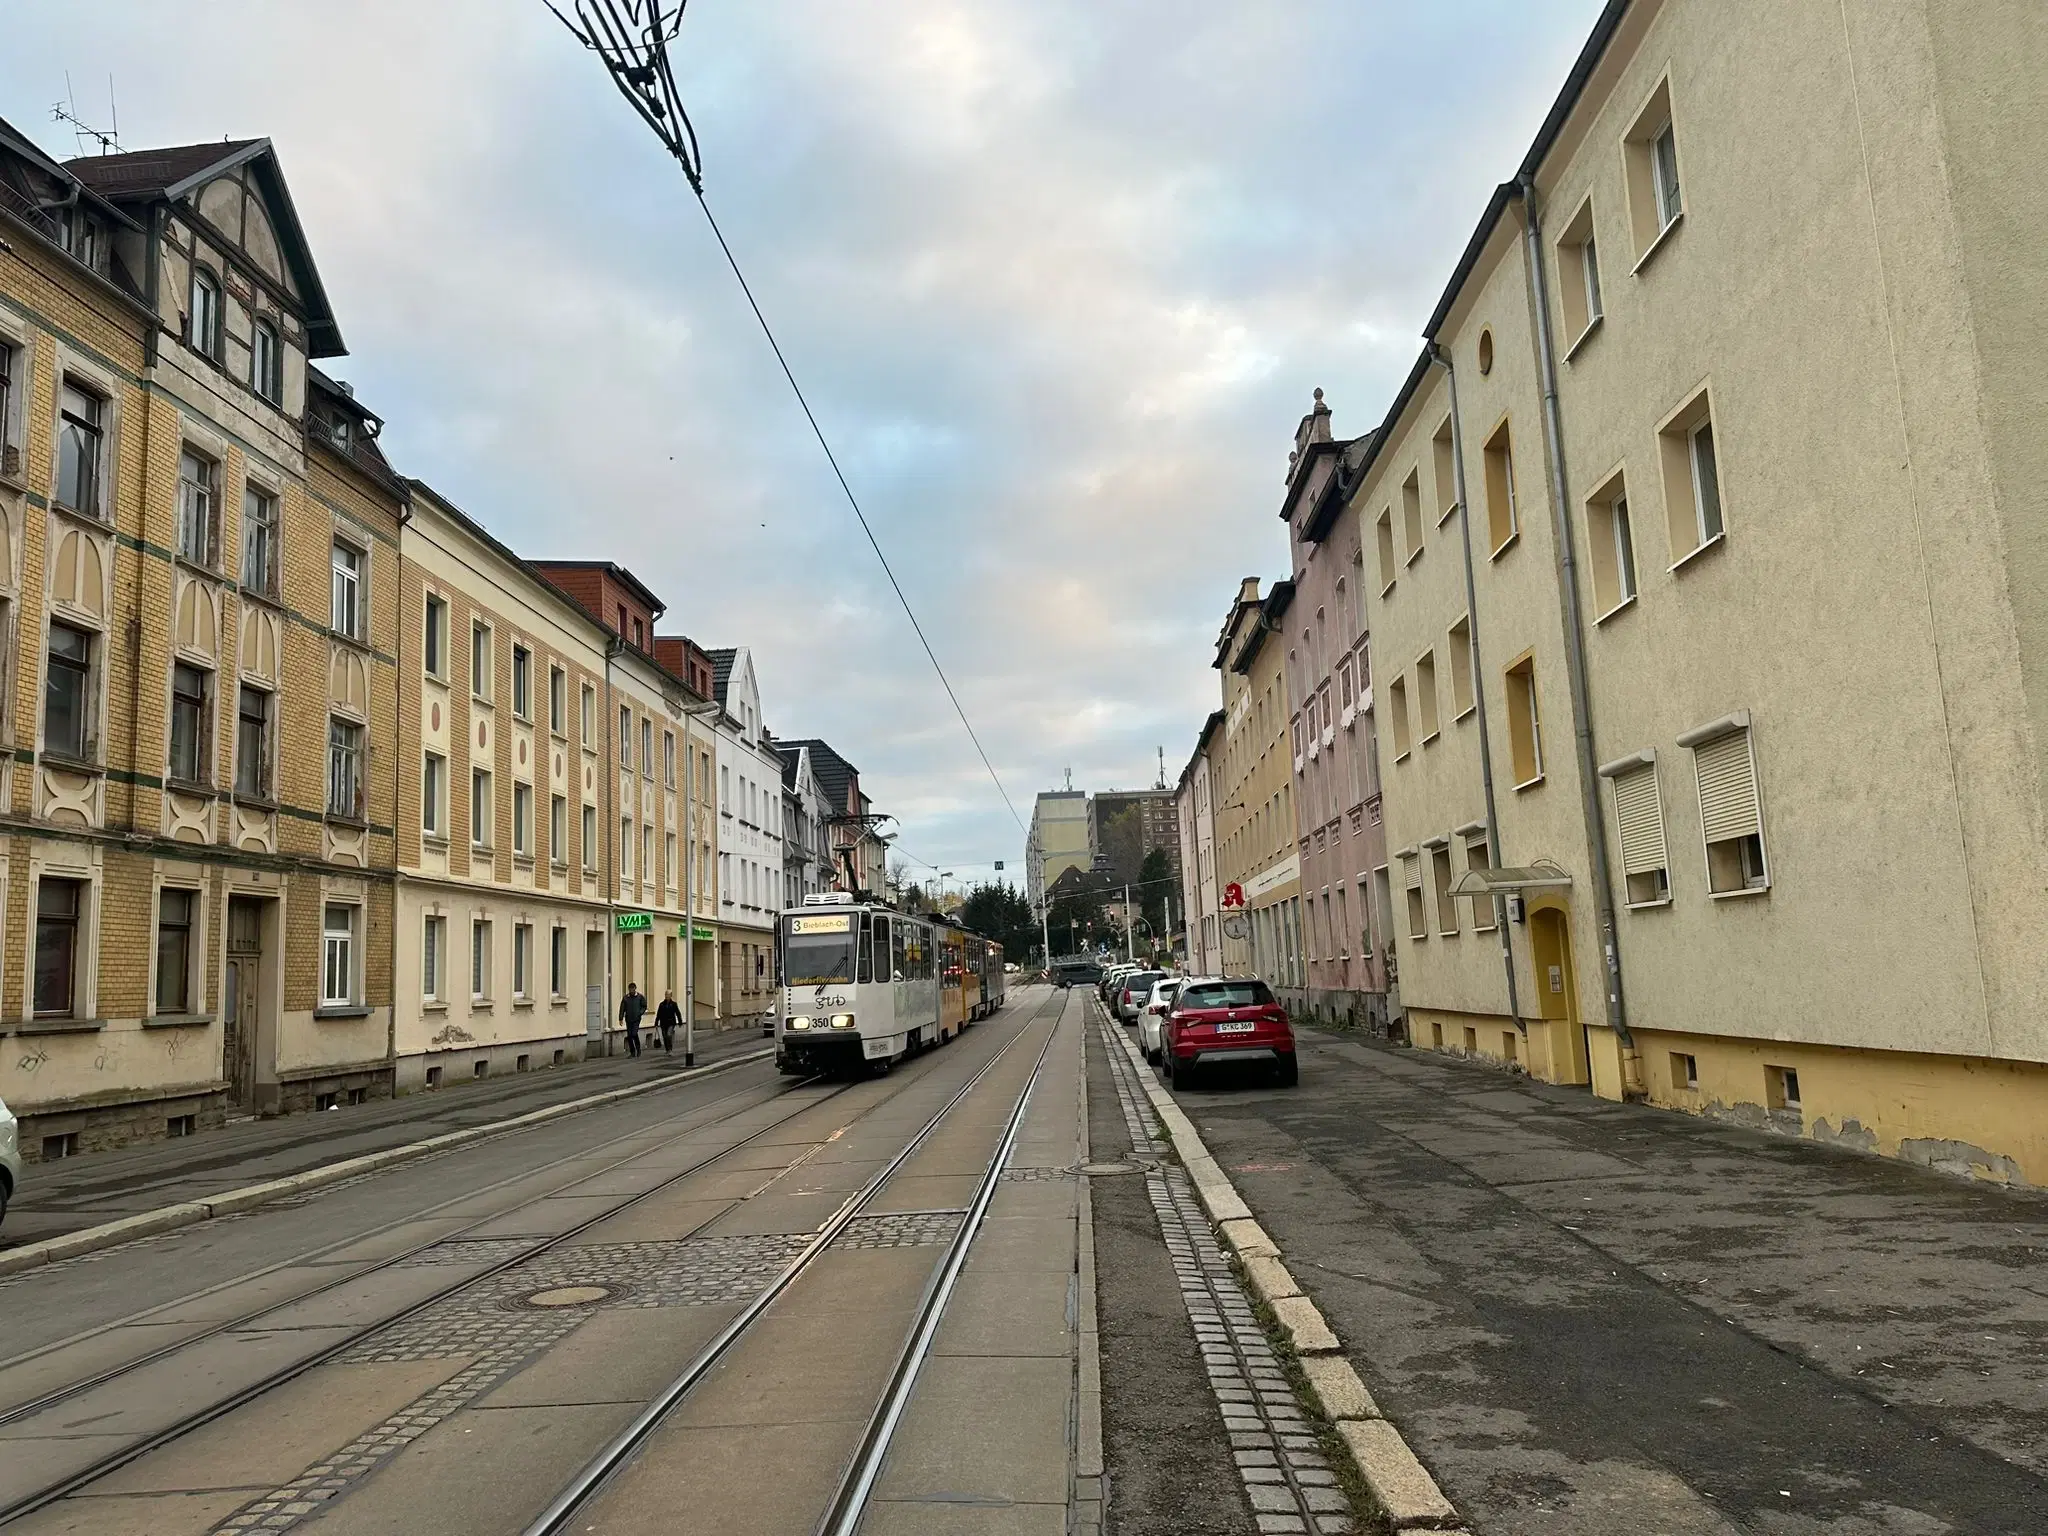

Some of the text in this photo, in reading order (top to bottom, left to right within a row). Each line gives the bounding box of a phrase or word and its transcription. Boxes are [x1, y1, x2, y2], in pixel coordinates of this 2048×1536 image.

[793, 920, 849, 932] 3 Bieblach-Ost
[812, 1017, 829, 1028] 350
